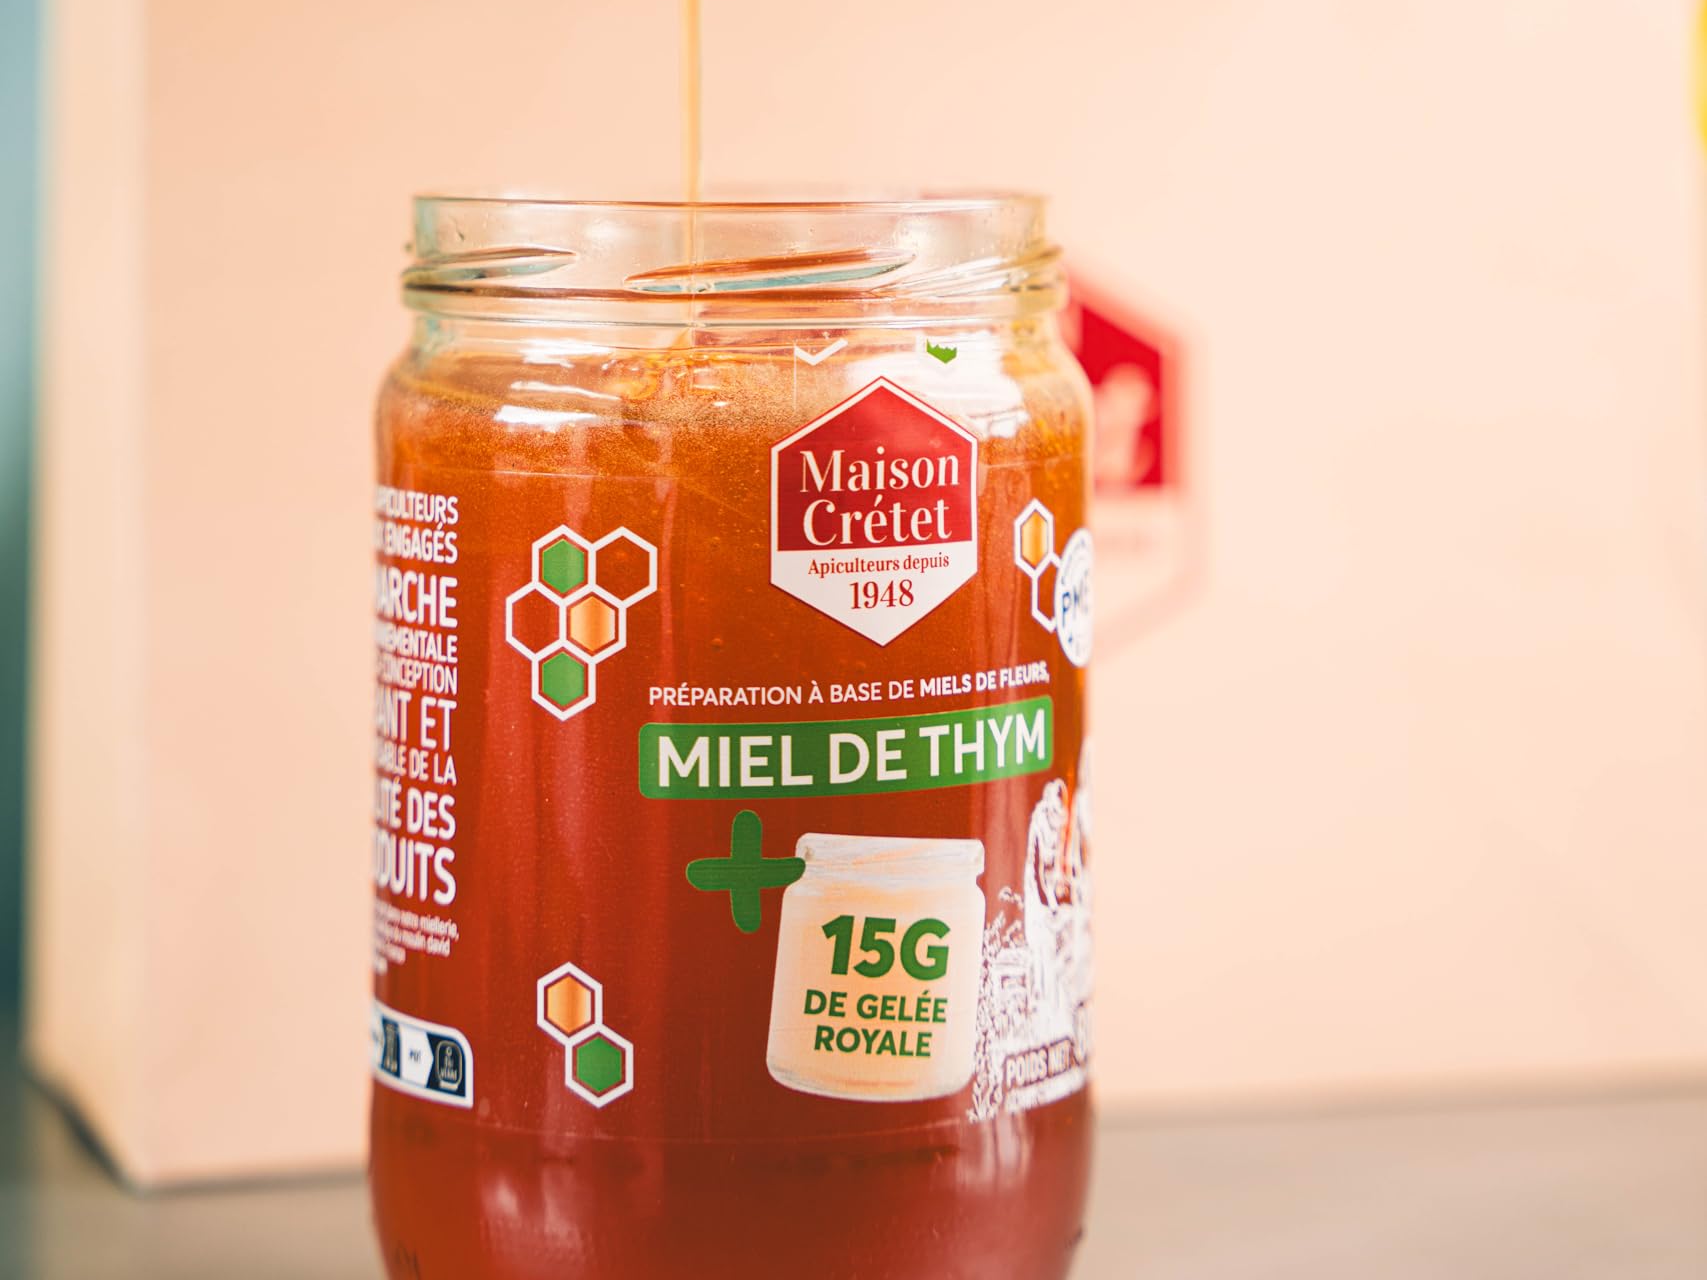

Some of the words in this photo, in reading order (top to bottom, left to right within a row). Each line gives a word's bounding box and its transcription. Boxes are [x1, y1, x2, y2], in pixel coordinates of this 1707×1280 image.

[799, 446, 960, 494] Maison
[803, 494, 953, 546] Crétet
[808, 553, 900, 579] Apiculteurs
[902, 552, 950, 574] depuis
[376, 563, 458, 629] ARCHE
[849, 578, 915, 611] 1948
[648, 681, 802, 706] PRÉPARATION
[807, 680, 824, 704] À
[830, 681, 883, 703] BASE
[888, 679, 915, 700] DE
[919, 670, 972, 698] MIELS
[975, 667, 998, 692] DE
[999, 660, 1050, 690] FLEURS,
[421, 696, 457, 752] ET
[658, 734, 813, 788] MIEL
[829, 728, 908, 785] DE
[918, 707, 1047, 778] THYM
[409, 747, 429, 782] DE
[433, 752, 458, 787] LA
[406, 787, 457, 840] DES
[821, 914, 951, 981] 15G
[803, 989, 848, 1018] DE
[856, 989, 949, 1024] GELÉE
[813, 1025, 933, 1057] ROYALE
[1005, 1048, 1047, 1089] POIDS
